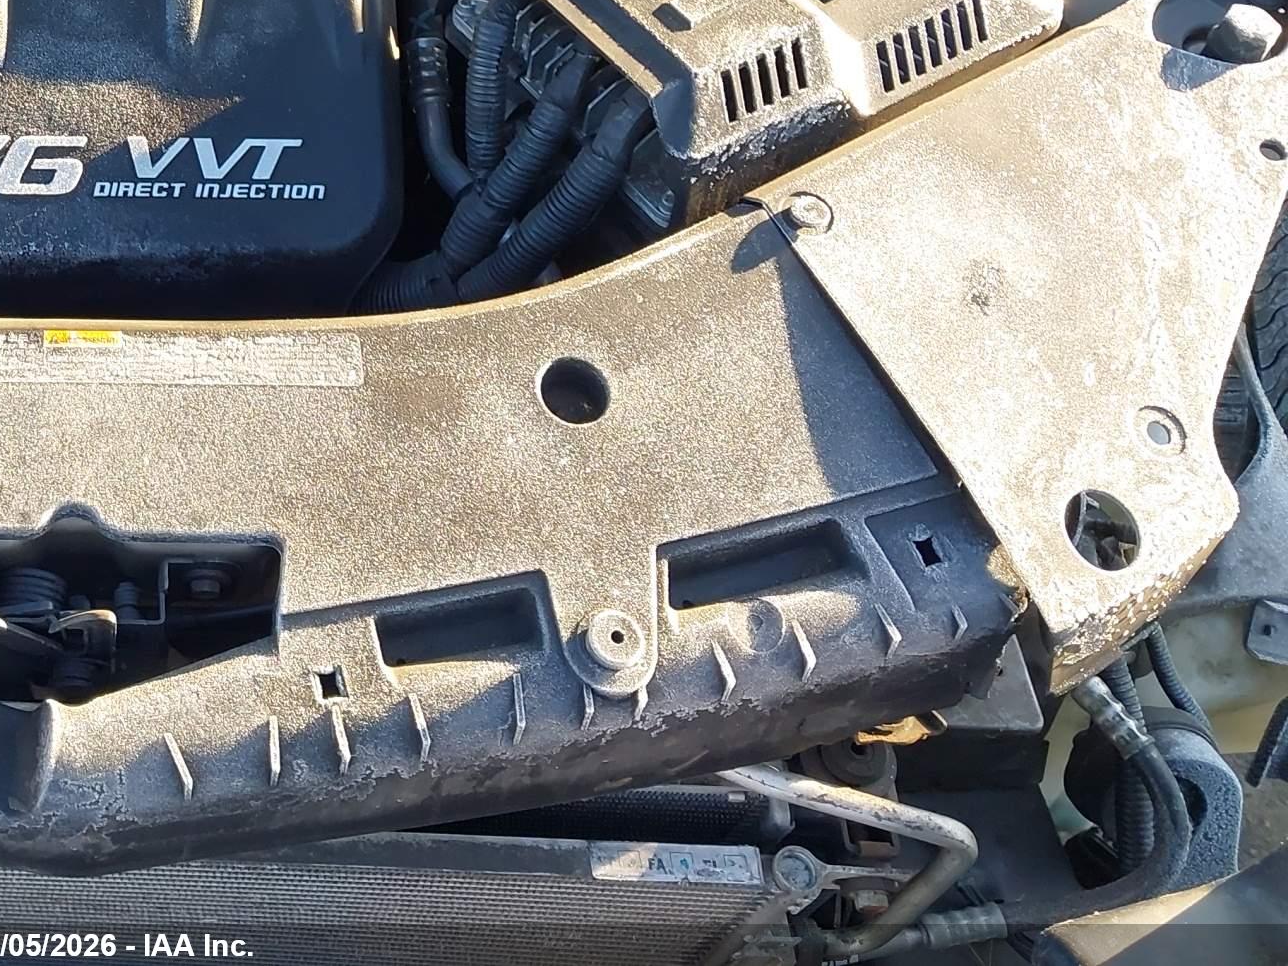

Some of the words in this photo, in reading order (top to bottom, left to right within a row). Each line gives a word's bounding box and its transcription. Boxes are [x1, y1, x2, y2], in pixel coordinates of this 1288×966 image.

[126, 135, 303, 180] VVT
[93, 181, 186, 198] DIRECT
[194, 183, 325, 200] INJECTION
